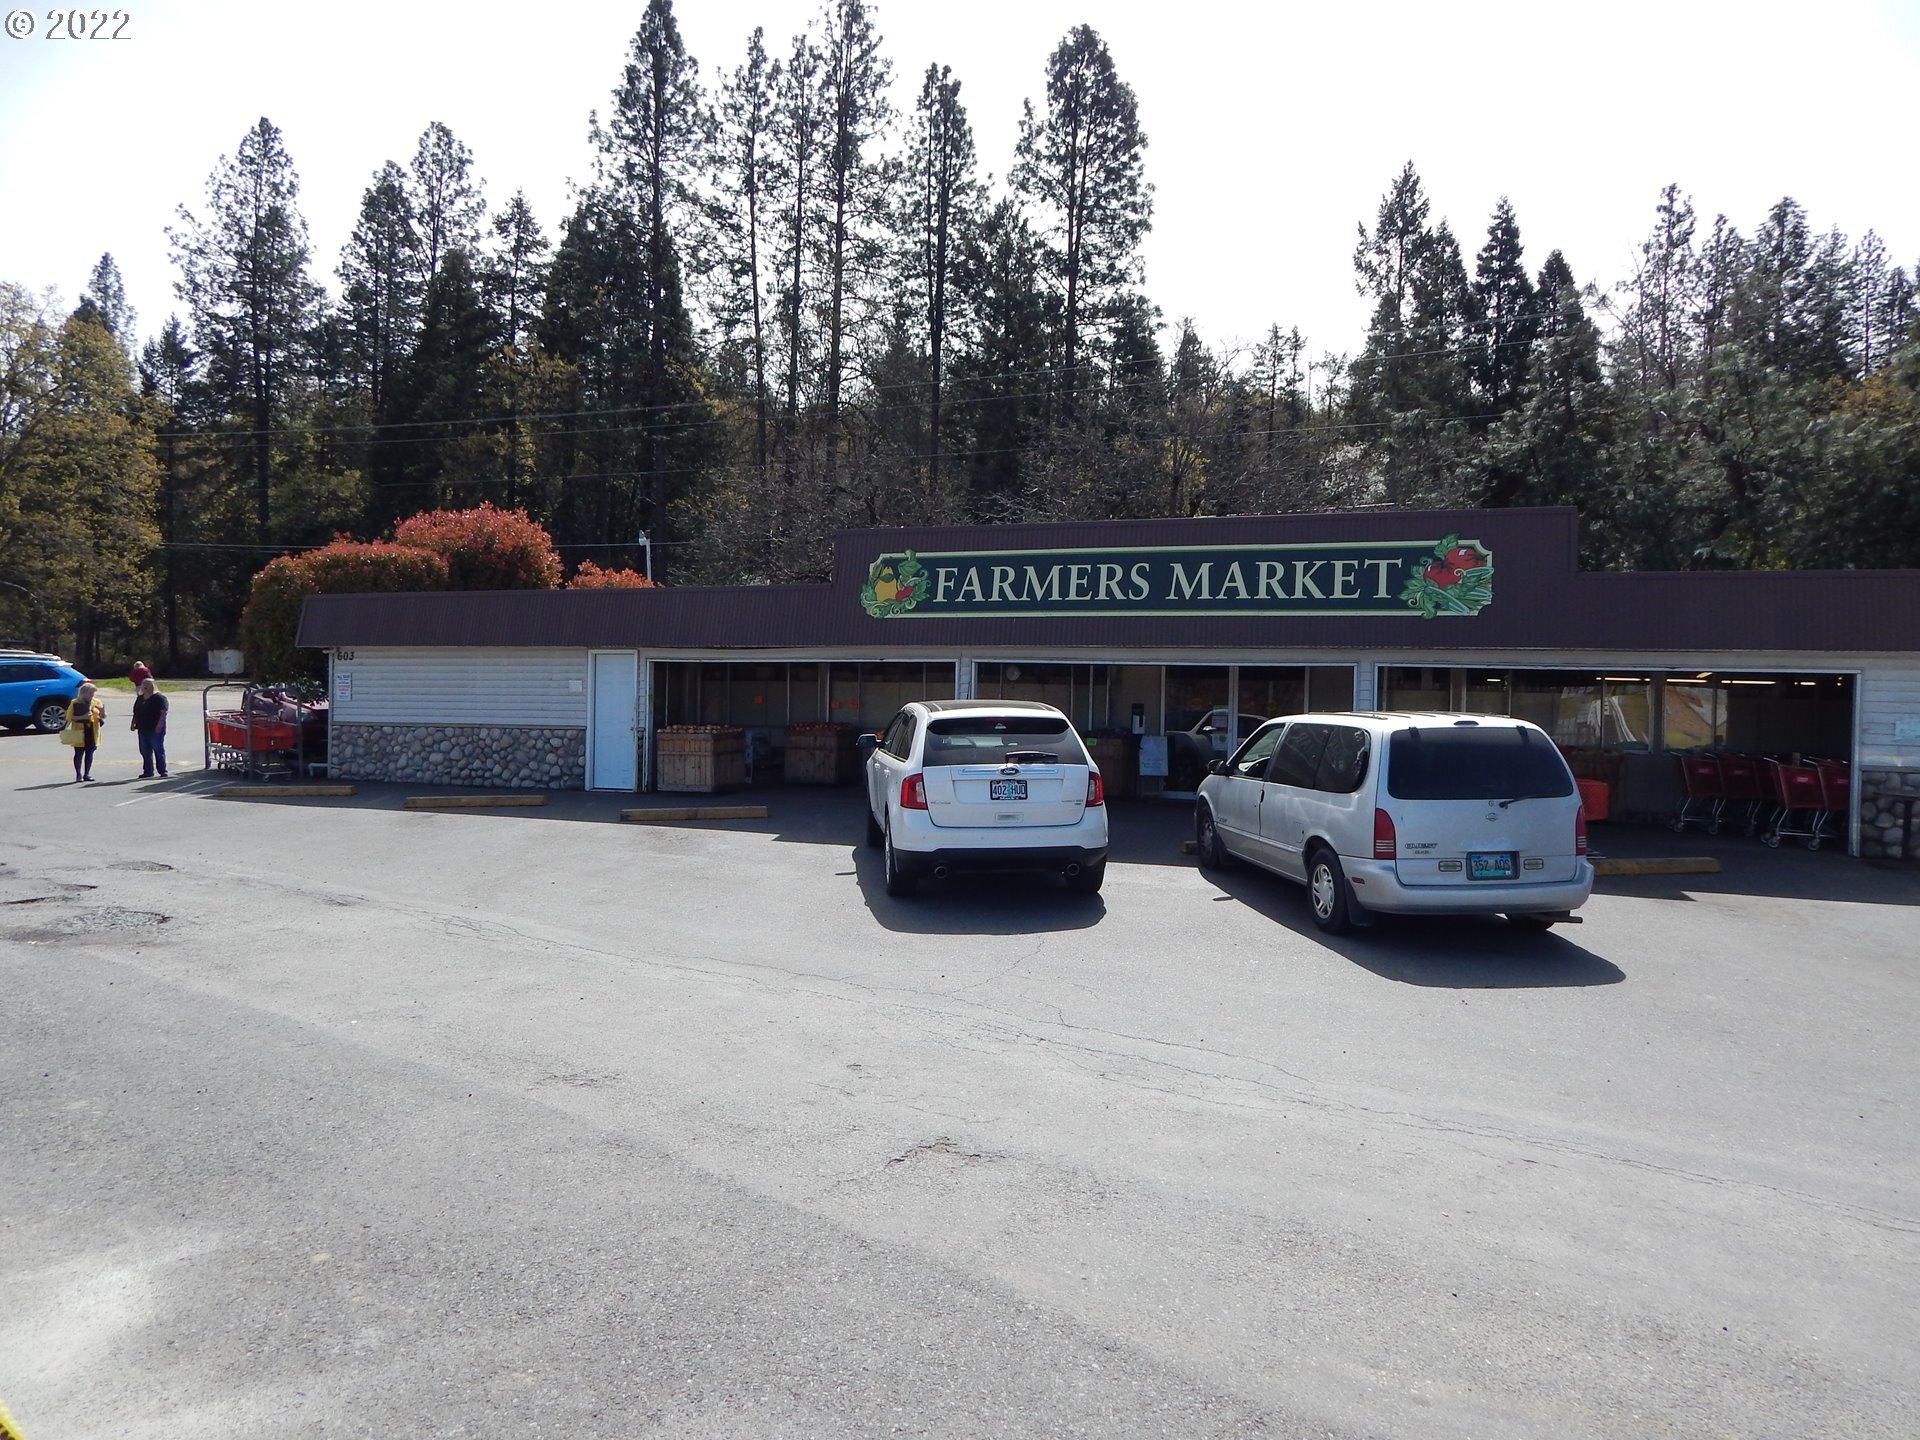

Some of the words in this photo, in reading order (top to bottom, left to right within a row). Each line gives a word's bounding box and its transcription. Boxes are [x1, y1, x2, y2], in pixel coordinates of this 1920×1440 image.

[932, 562, 1150, 602] FARMERS
[1165, 558, 1402, 600] MARKET
[337, 651, 354, 661] 603
